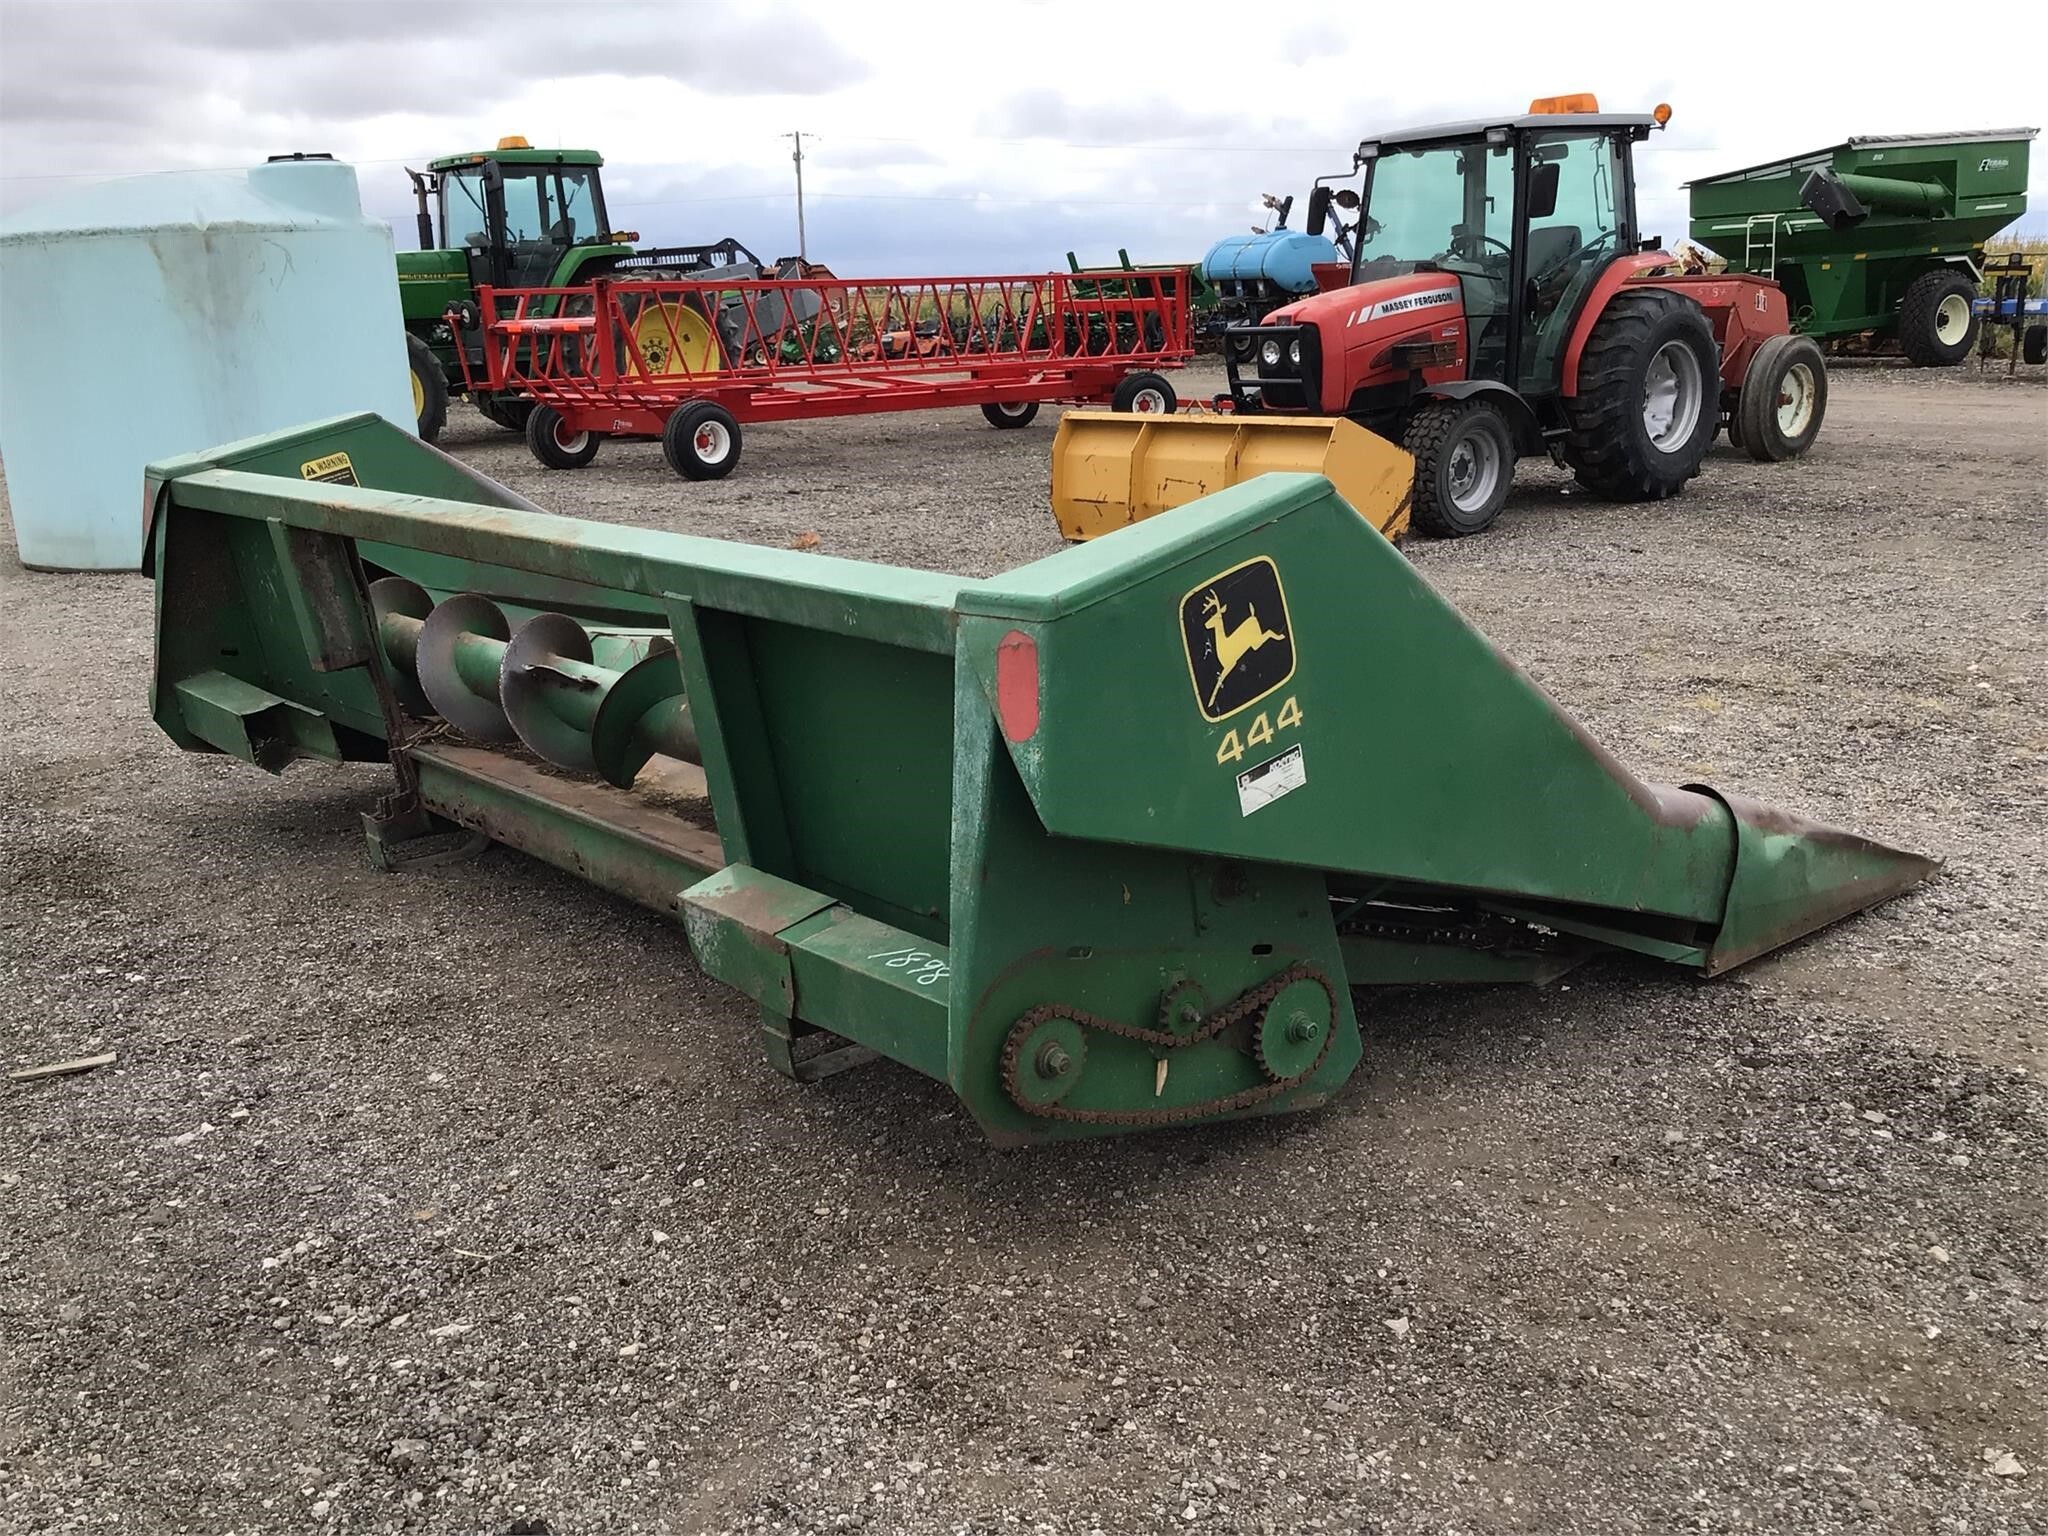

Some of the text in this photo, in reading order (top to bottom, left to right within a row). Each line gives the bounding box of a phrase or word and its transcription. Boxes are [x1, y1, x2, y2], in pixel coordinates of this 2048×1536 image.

[1381, 292, 1453, 314] MASSEY FERGUSON
[315, 454, 349, 472] WARNING
[1216, 695, 1303, 765] 444
